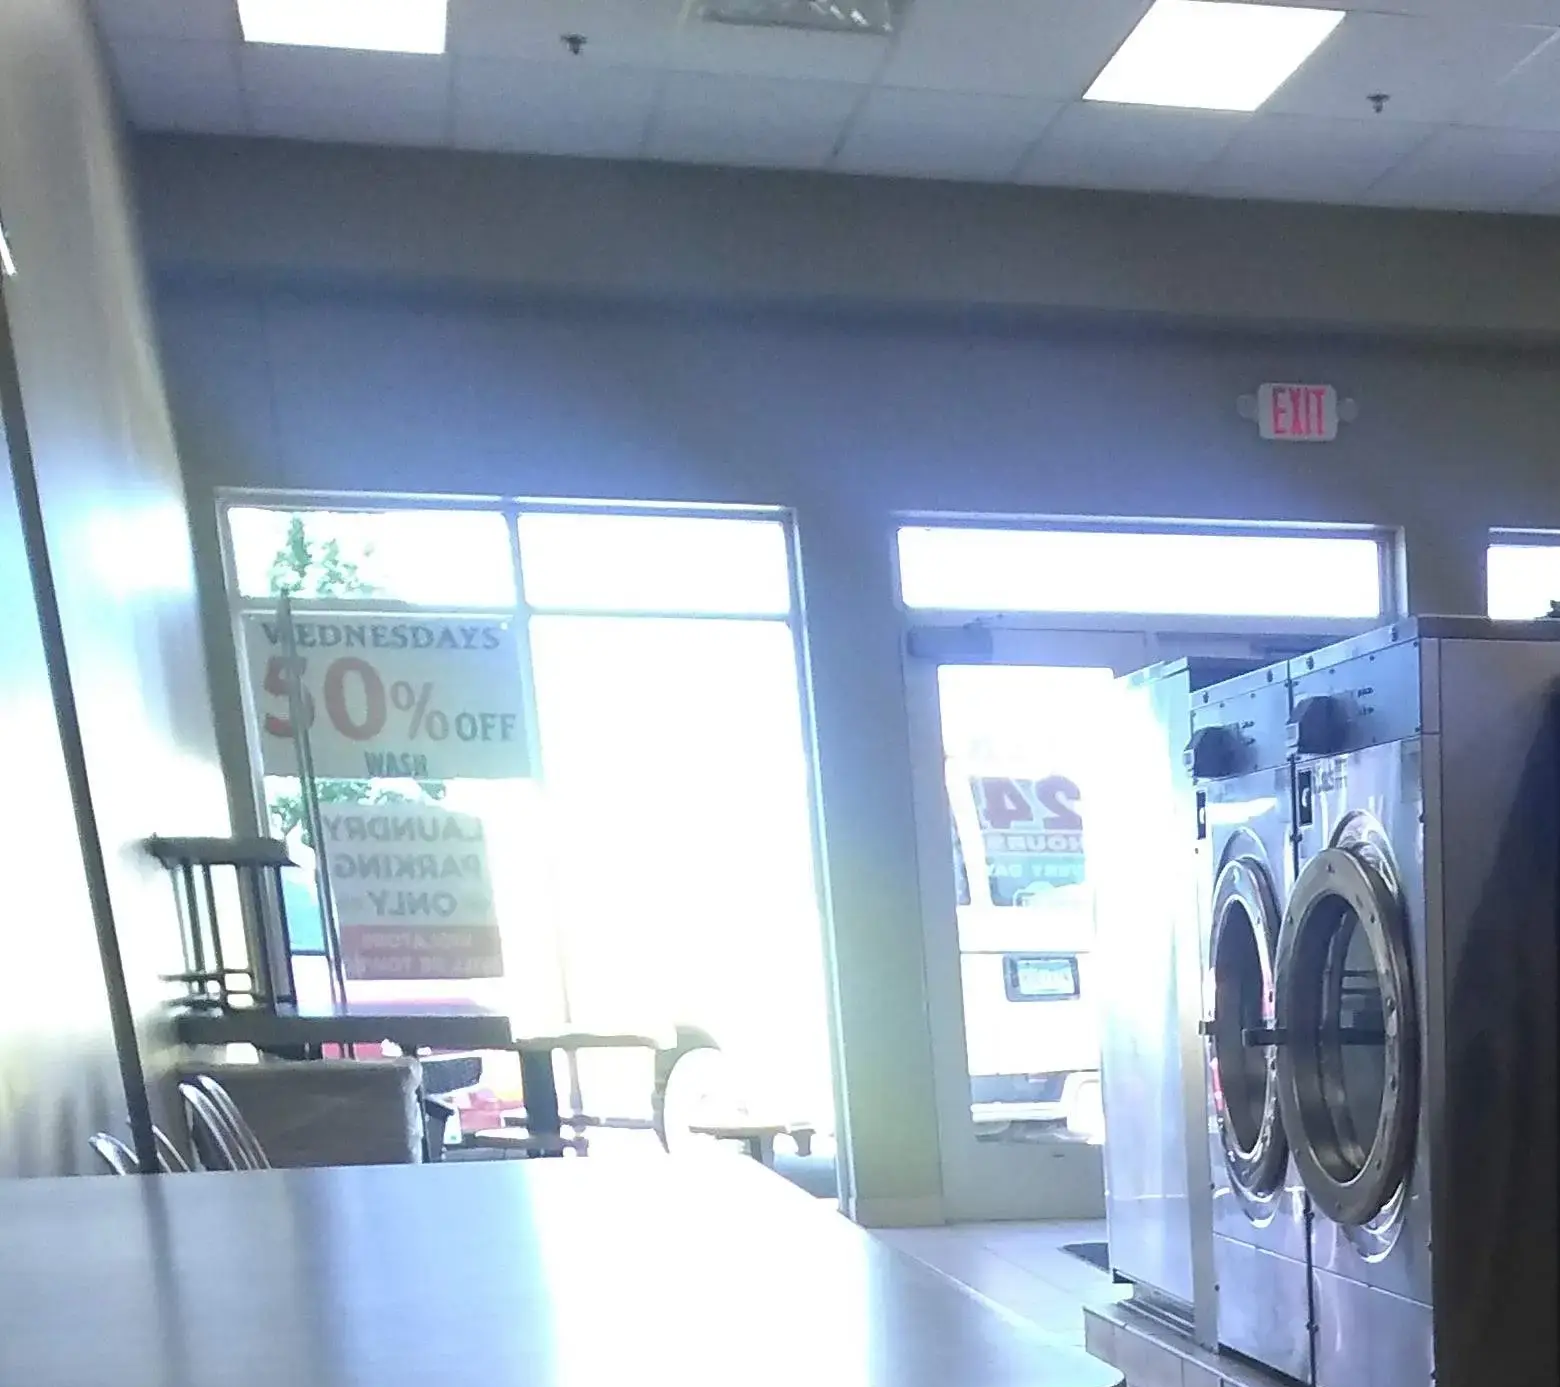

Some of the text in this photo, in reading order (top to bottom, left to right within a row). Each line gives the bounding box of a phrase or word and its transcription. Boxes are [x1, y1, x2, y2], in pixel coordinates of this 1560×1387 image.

[1273, 387, 1326, 435] EXIT
[454, 711, 517, 742] OFF
[363, 751, 428, 777] WASH
